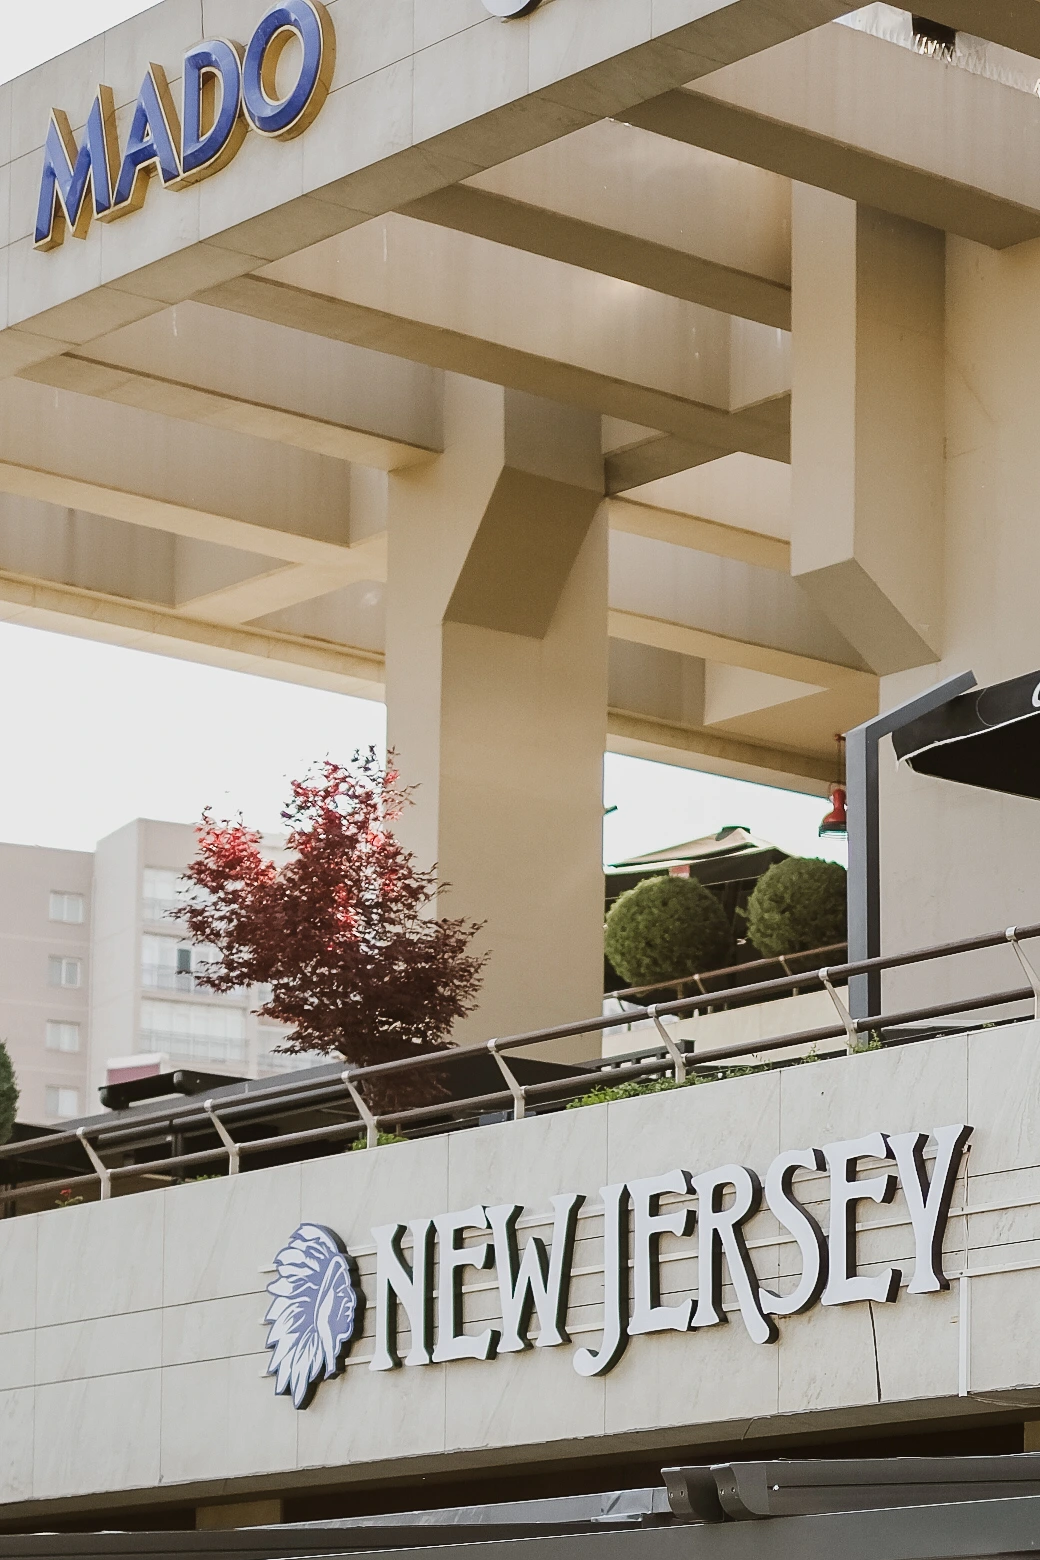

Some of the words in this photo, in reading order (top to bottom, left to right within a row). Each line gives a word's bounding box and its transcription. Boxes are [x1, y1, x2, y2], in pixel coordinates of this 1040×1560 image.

[33, 0, 338, 251] MADO
[368, 1192, 587, 1371] NEW
[573, 1123, 974, 1377] JERSEY
